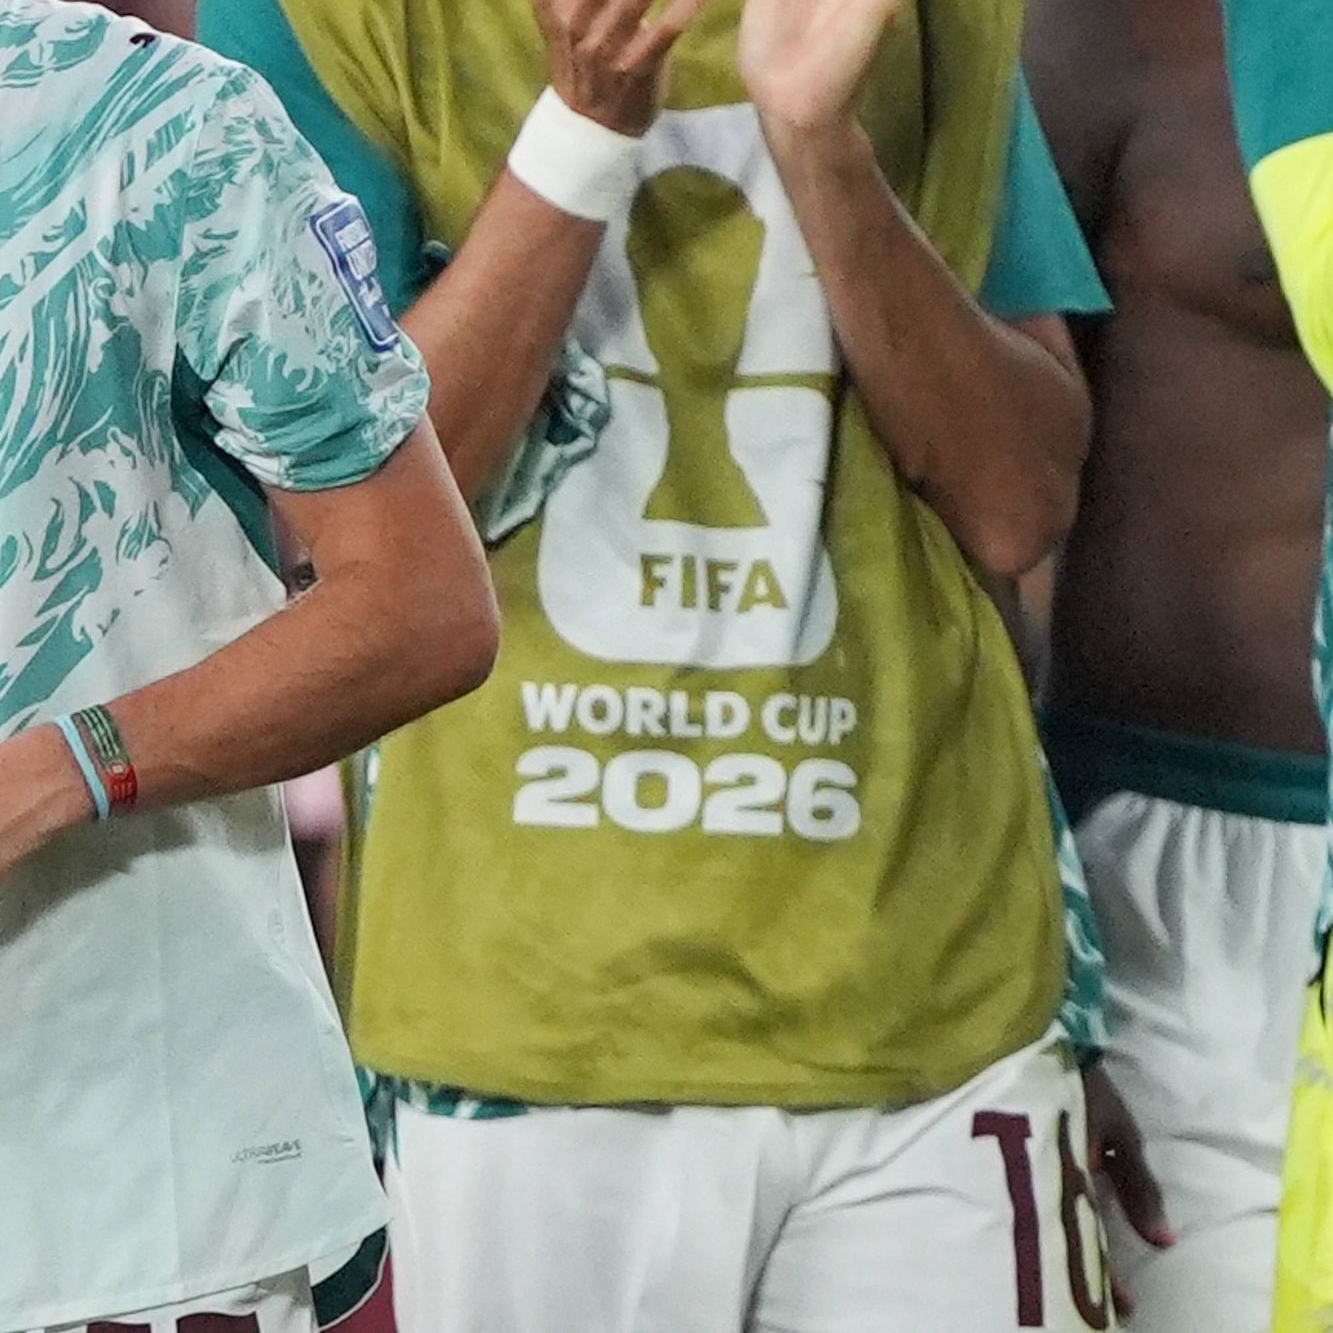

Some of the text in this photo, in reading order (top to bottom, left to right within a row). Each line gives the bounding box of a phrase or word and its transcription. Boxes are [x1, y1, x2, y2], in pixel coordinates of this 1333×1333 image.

[640, 553, 789, 615] FIFA
[521, 680, 858, 746] WORLD CUP
[513, 745, 861, 842] 2026
